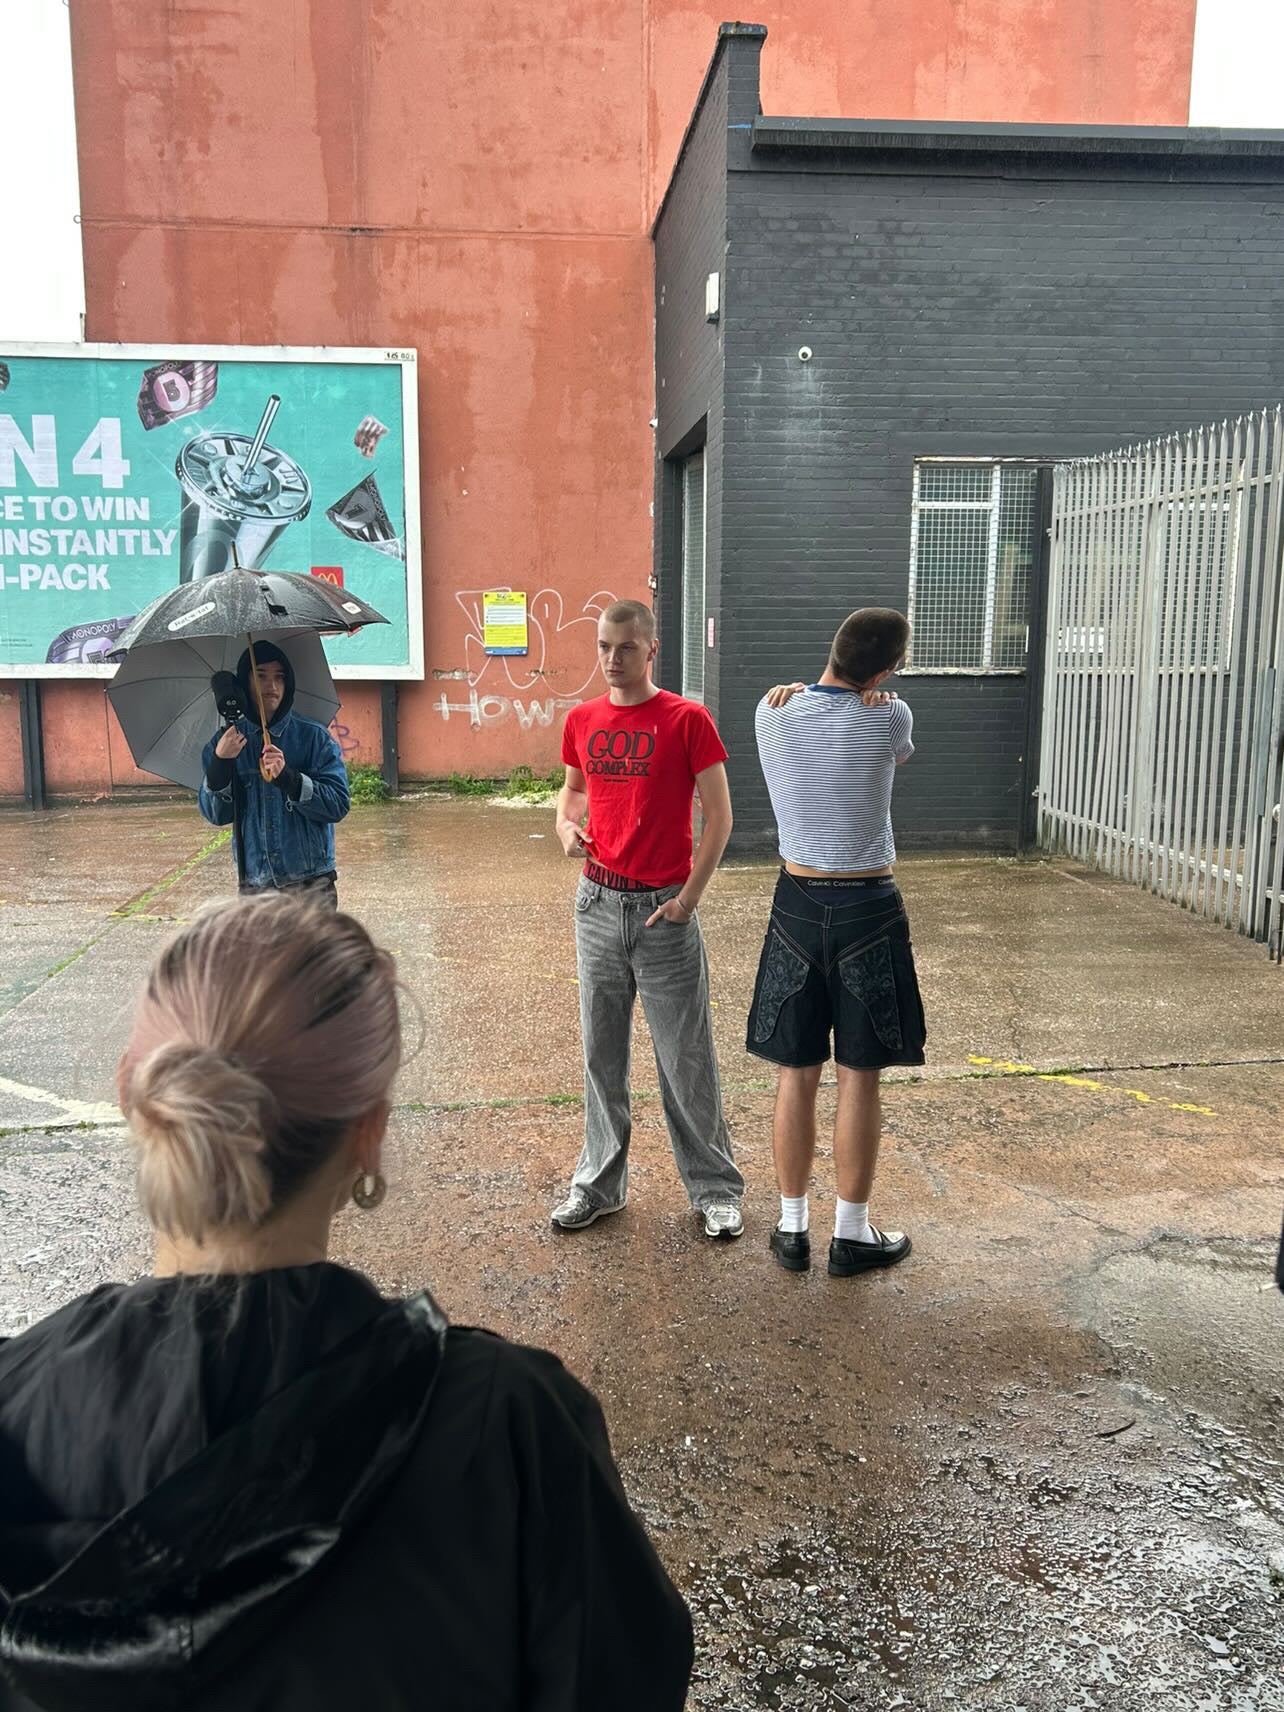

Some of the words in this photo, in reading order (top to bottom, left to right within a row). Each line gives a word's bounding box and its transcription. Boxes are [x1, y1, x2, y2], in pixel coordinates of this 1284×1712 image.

[72, 417, 131, 489] 4
[0, 496, 25, 521] E
[28, 496, 78, 522] TO
[81, 496, 150, 521] WIN
[0, 528, 178, 557] NSTANTLY
[71, 622, 116, 640] MONOPOLY
[587, 729, 656, 760] GOD
[586, 760, 651, 777] COMPLEX
[587, 863, 632, 890] CALVIN
